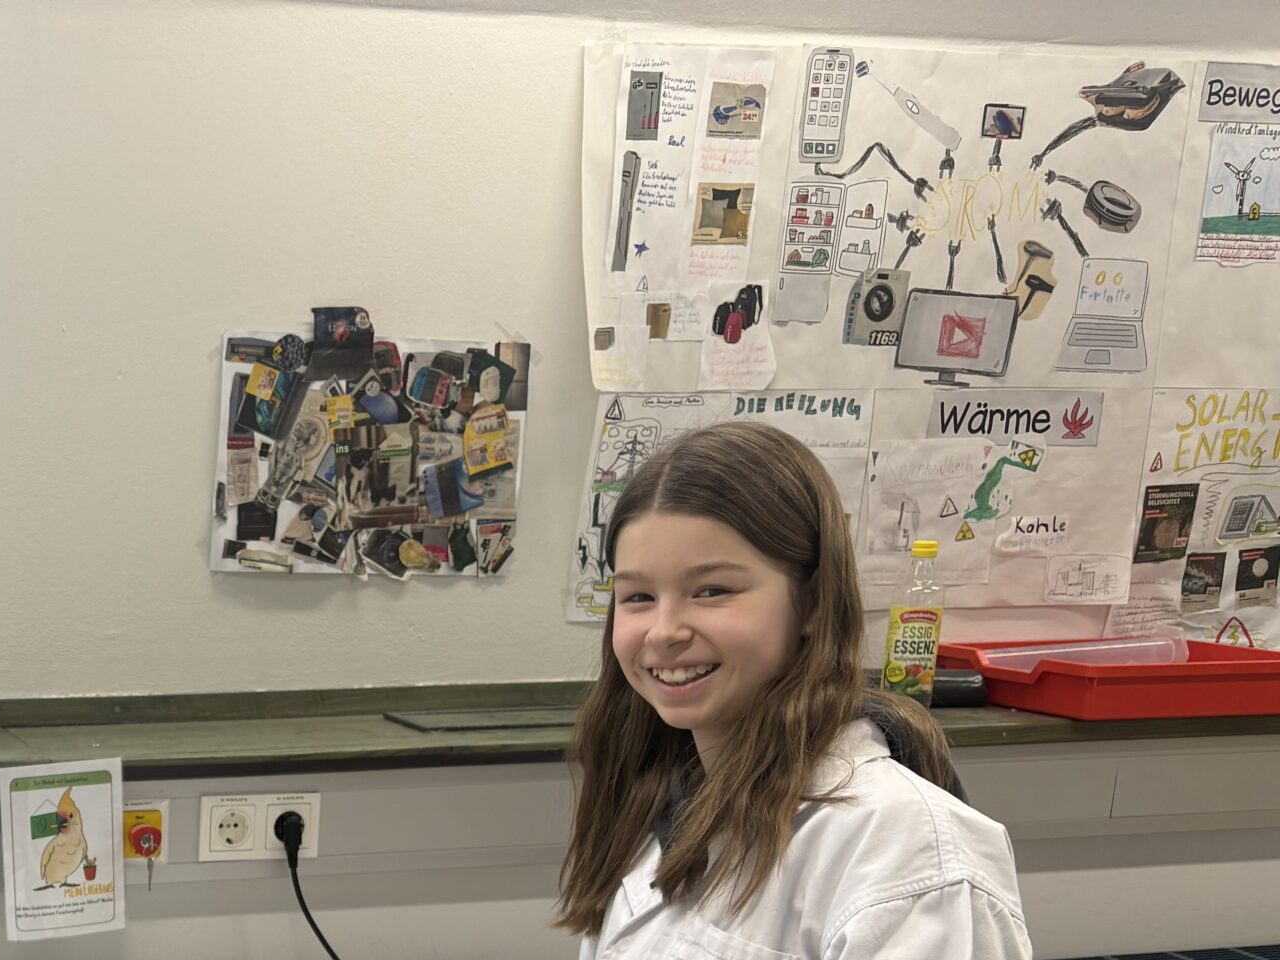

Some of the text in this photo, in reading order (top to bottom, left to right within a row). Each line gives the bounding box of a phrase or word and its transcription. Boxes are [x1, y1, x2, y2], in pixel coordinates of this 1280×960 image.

[733, 392, 861, 420] DIE HEIZUNG
[940, 402, 1051, 434] Wärme
[1015, 515, 1066, 534] Kohle
[902, 625, 933, 639] ESSIG
[894, 639, 936, 655] ESSENZ
